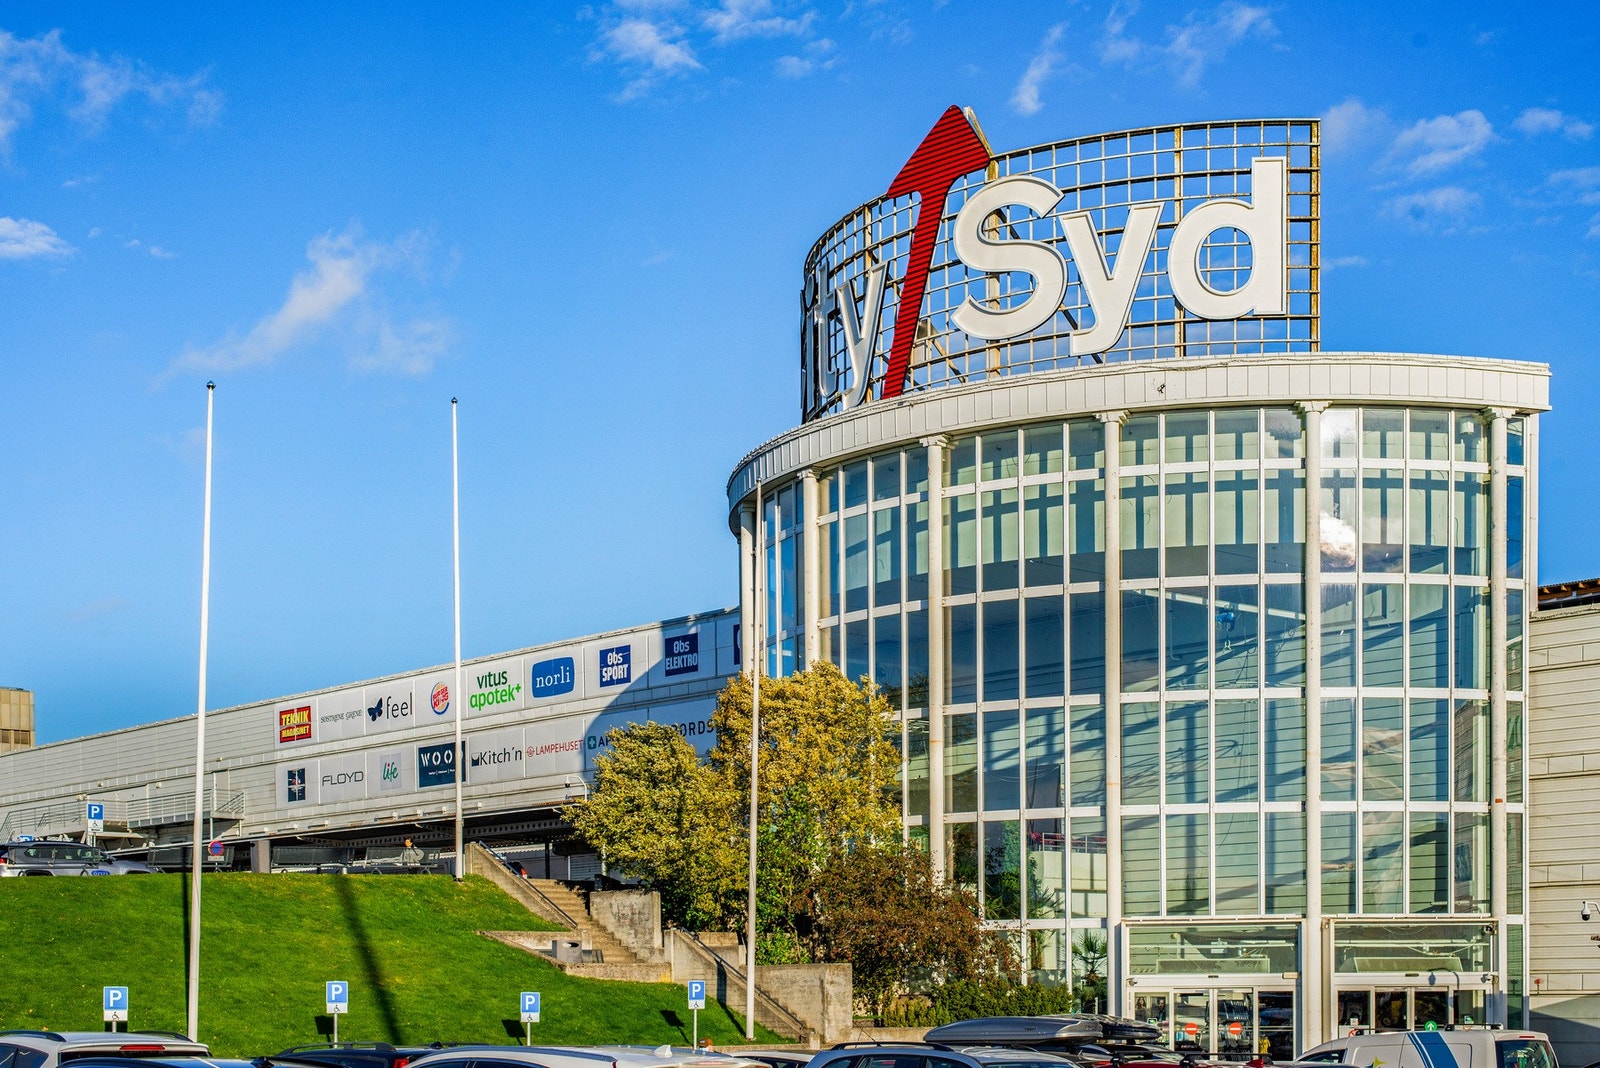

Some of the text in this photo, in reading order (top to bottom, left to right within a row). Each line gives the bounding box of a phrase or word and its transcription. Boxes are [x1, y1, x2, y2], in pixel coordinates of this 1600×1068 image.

[800, 156, 1287, 416] ity Syd
[665, 652, 698, 670] ELEKTRO
[477, 671, 508, 689] vitus
[535, 666, 570, 689] norli
[602, 664, 628, 682] SPORT
[386, 692, 412, 719] feel
[281, 710, 309, 726] TEKNIK
[535, 739, 583, 757] LAMPEHUSET
[322, 771, 364, 787] FLOYD
[91, 805, 100, 818] P
[109, 989, 122, 1008] P
[331, 984, 343, 1001] P
[692, 983, 701, 998] P
[525, 995, 536, 1011] P
